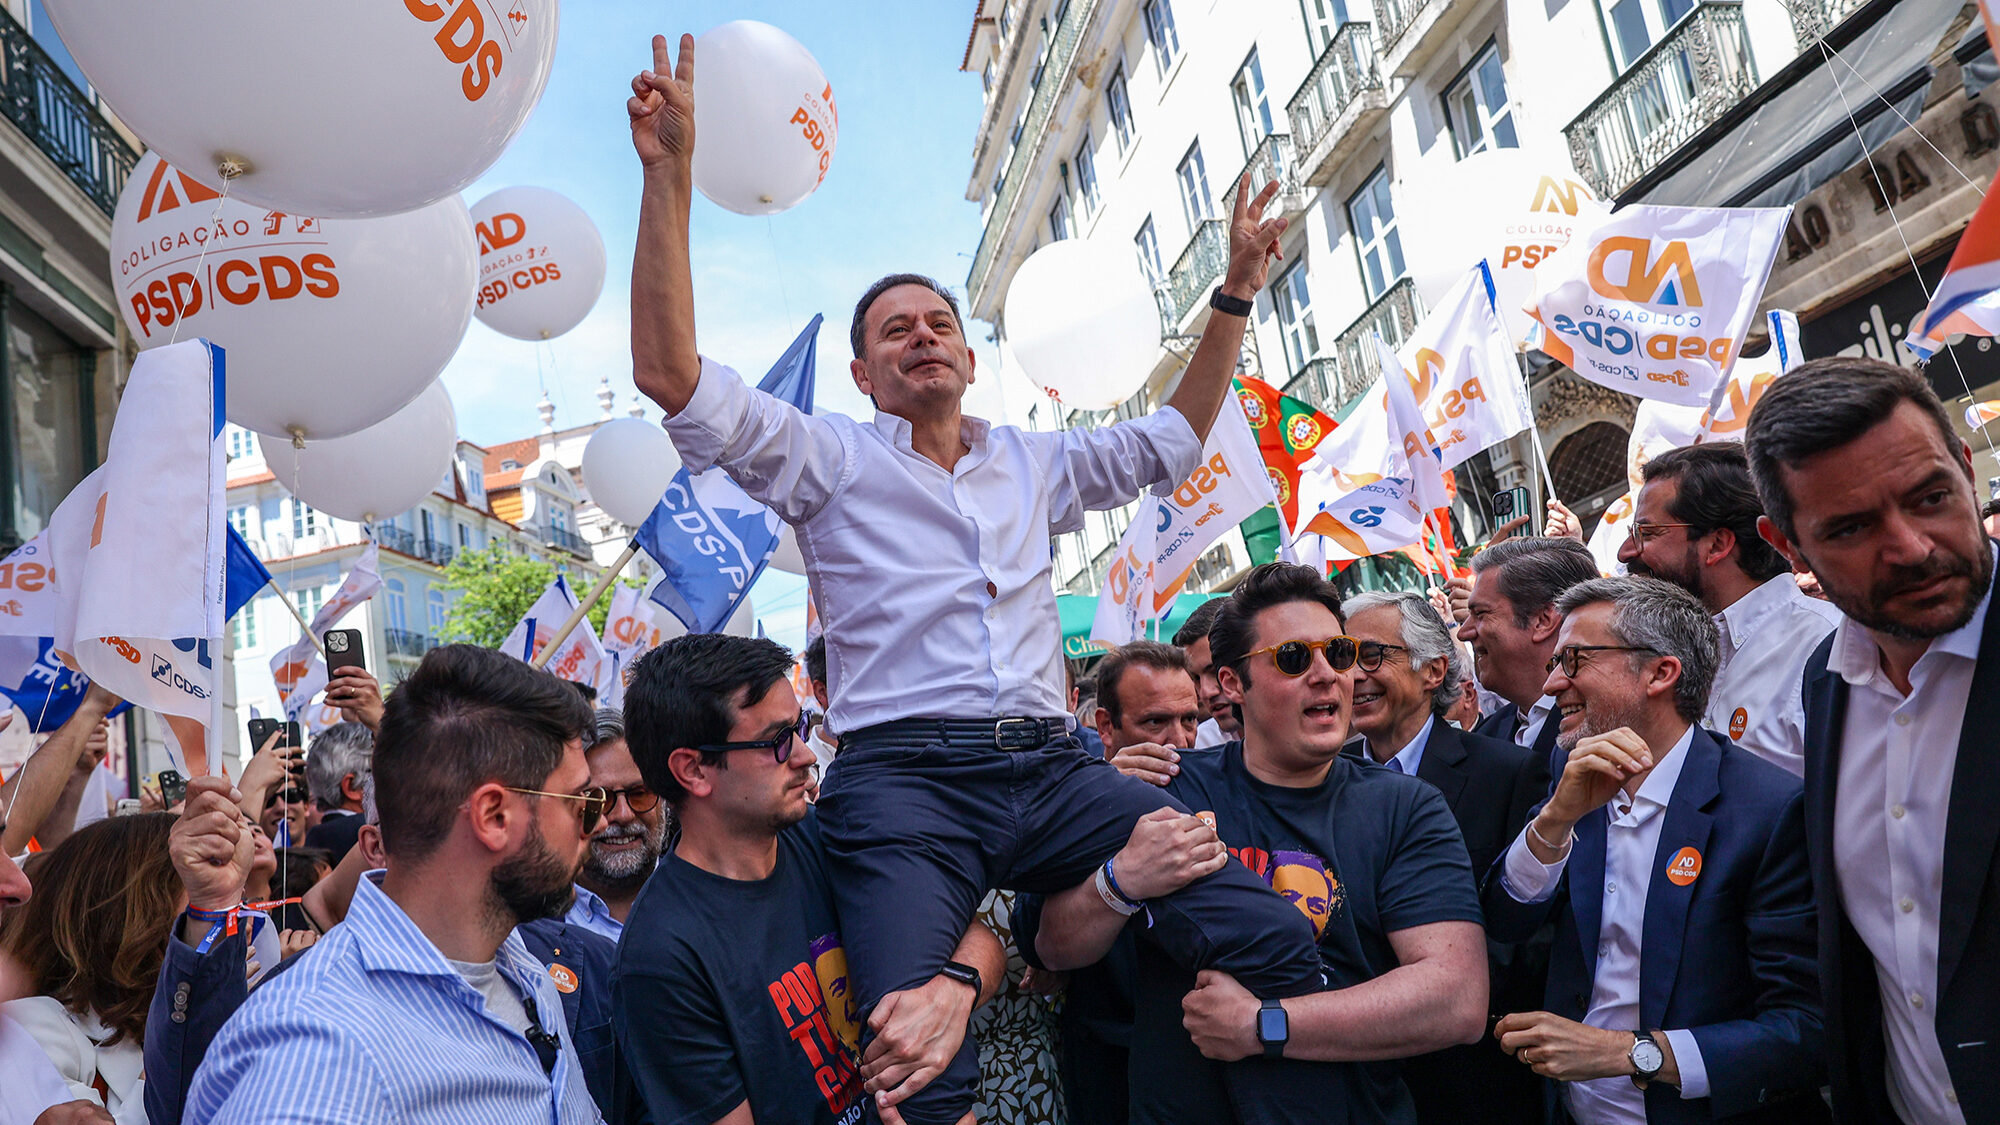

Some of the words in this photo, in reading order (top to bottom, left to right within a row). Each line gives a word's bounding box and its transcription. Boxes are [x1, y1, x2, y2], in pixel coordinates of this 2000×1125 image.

[789, 106, 825, 151] PSD
[1506, 224, 1572, 238] COLIGAÇ
[121, 218, 249, 275] COLIGAÇÃO
[512, 262, 561, 290] CDS
[131, 271, 203, 338] PSD
[216, 253, 340, 306] CDS
[174, 673, 212, 699] CDS-
[1679, 856, 1695, 868] AD
